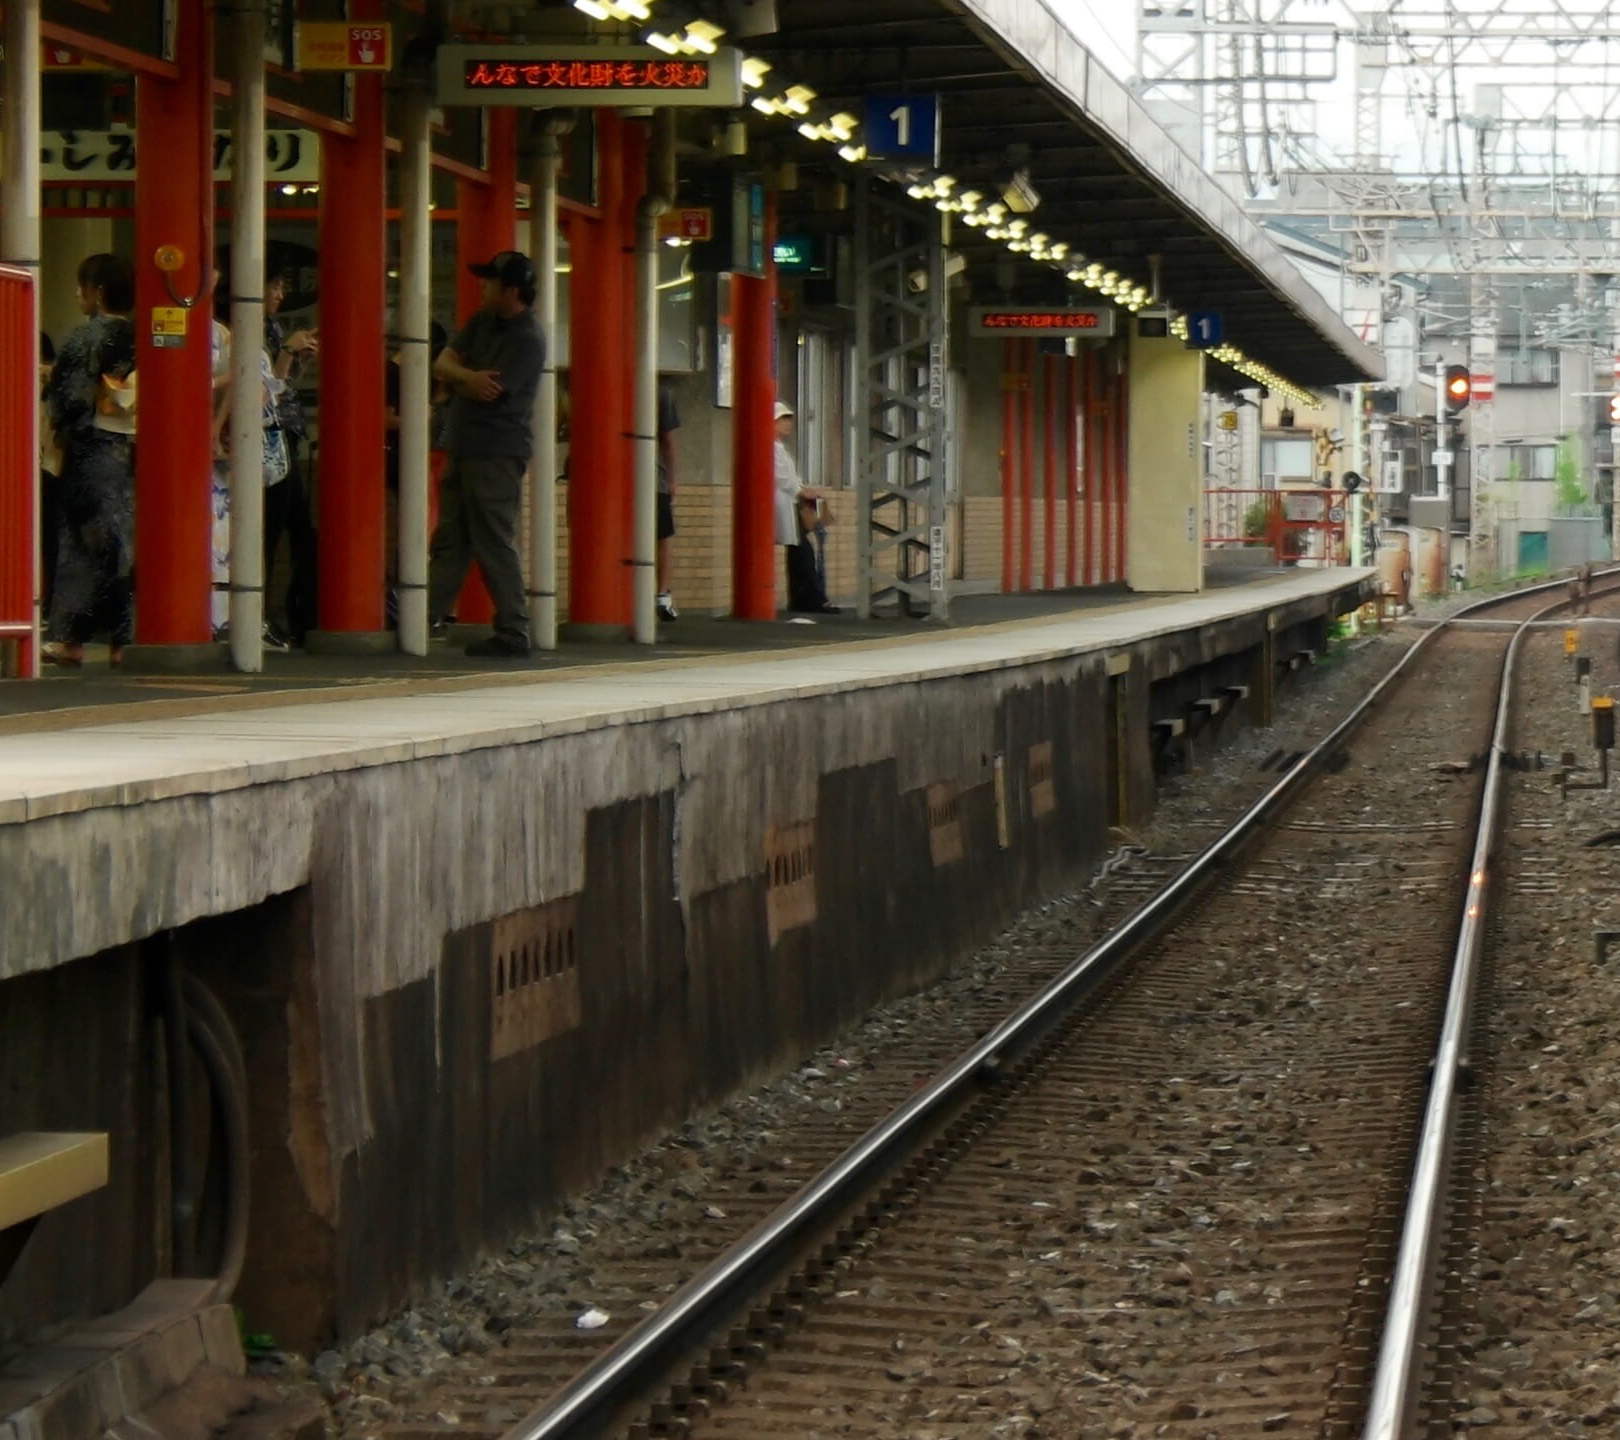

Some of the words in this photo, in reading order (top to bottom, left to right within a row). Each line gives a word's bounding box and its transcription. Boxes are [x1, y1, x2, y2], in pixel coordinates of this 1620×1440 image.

[352, 29, 382, 41] SOS
[890, 105, 910, 146] 1
[1197, 318, 1212, 340] 1
